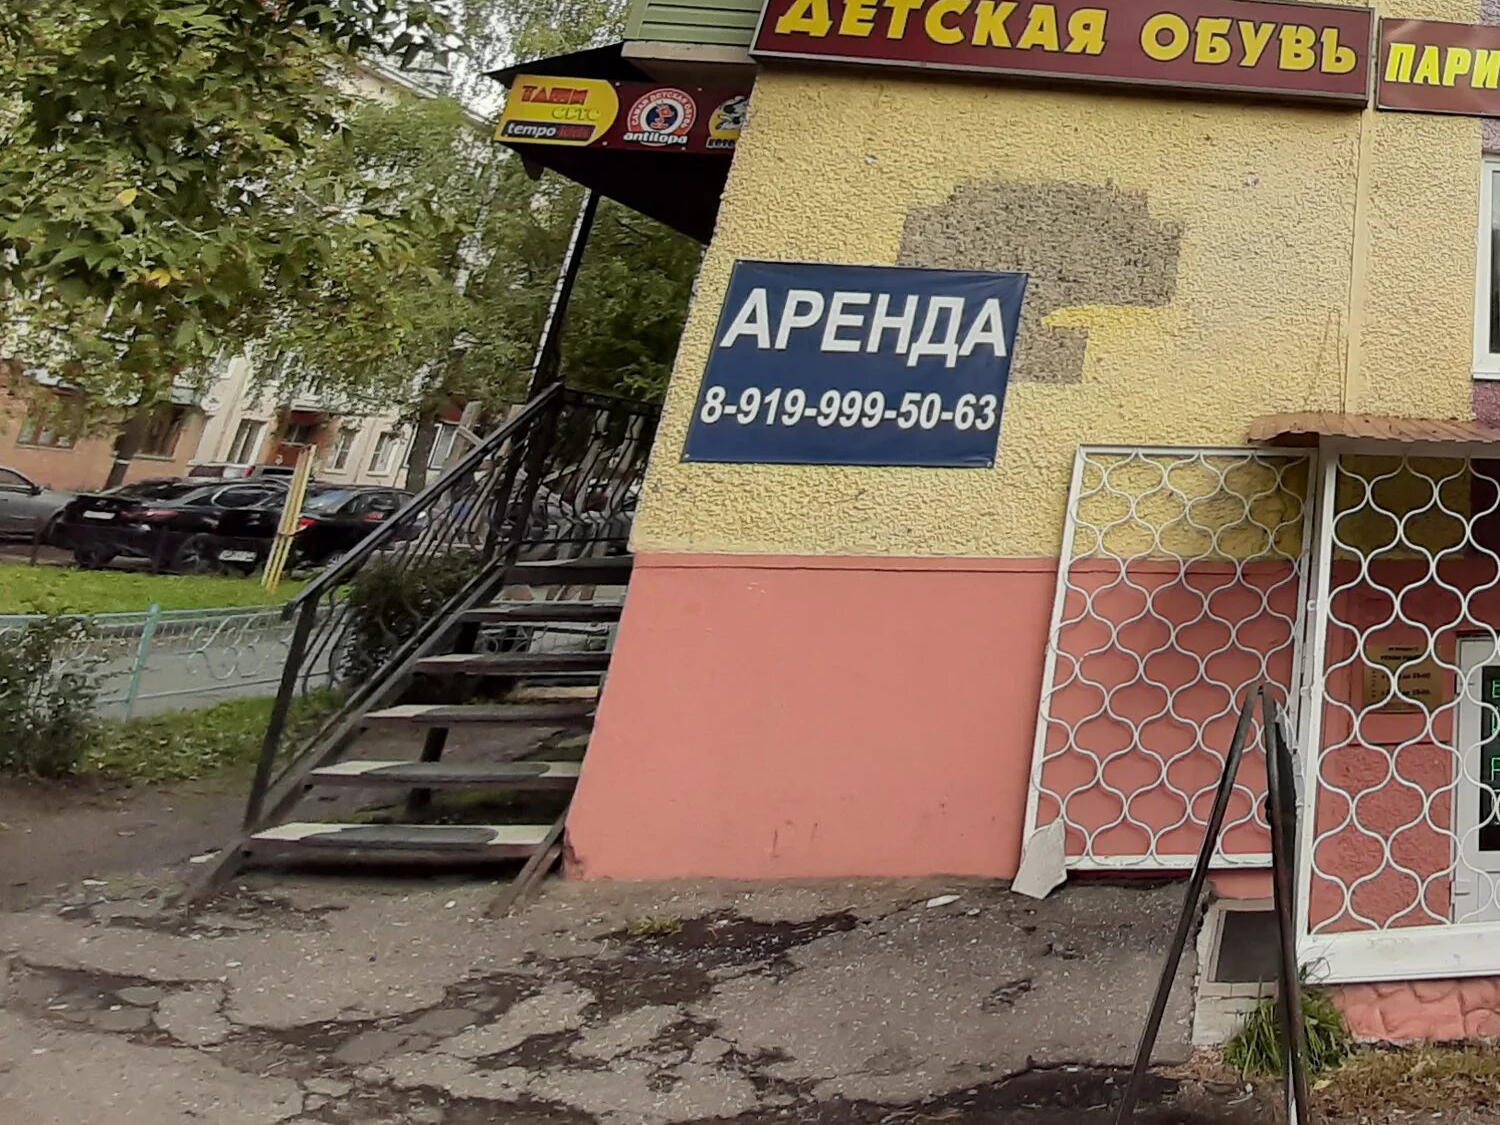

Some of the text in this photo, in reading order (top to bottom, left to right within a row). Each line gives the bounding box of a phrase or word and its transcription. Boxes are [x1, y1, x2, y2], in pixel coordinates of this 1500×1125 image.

[1140, 11, 1358, 74] ОБУВЬ
[507, 122, 556, 138] tempo
[623, 131, 688, 145] antilopa
[719, 287, 1008, 368] АРЕНДА
[700, 385, 997, 431] 8-919-999-50-63
